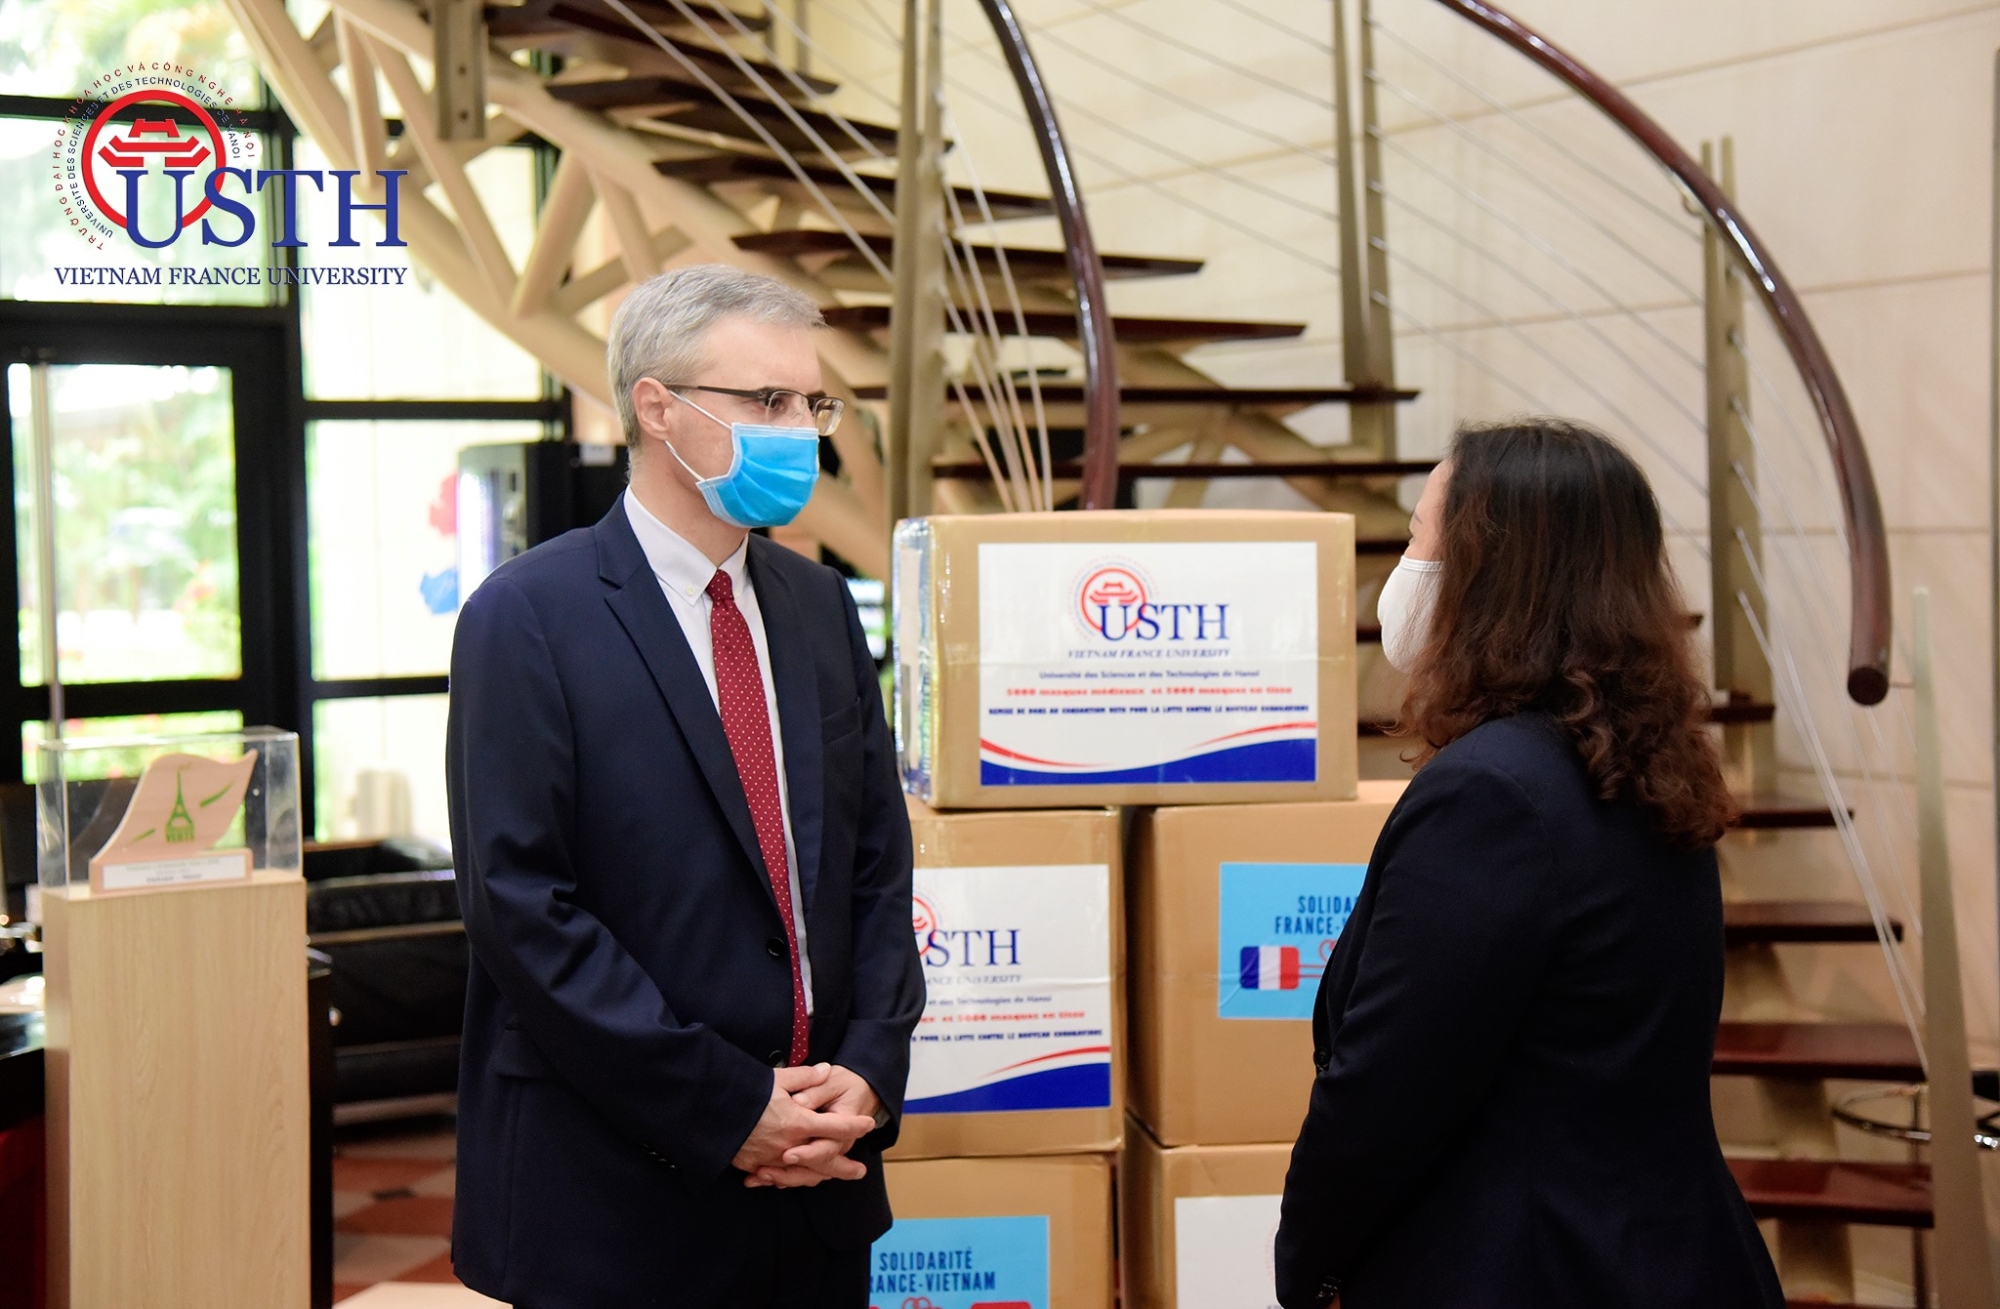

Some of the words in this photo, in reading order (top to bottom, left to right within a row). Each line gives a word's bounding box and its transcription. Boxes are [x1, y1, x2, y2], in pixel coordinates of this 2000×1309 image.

[1097, 602, 1230, 642] USTH
[1067, 648, 1118, 660] VIETNAM
[1120, 648, 1162, 659] FRANCE
[1165, 648, 1231, 659] UNIVERSITY
[1084, 671, 1099, 679] des
[1101, 671, 1136, 679] Sciences
[1166, 670, 1220, 680] Technologies
[914, 928, 1022, 968] STH
[879, 1246, 973, 1271] SOLIDARITÉ
[870, 1271, 996, 1294] RANCE-VIETNAM
